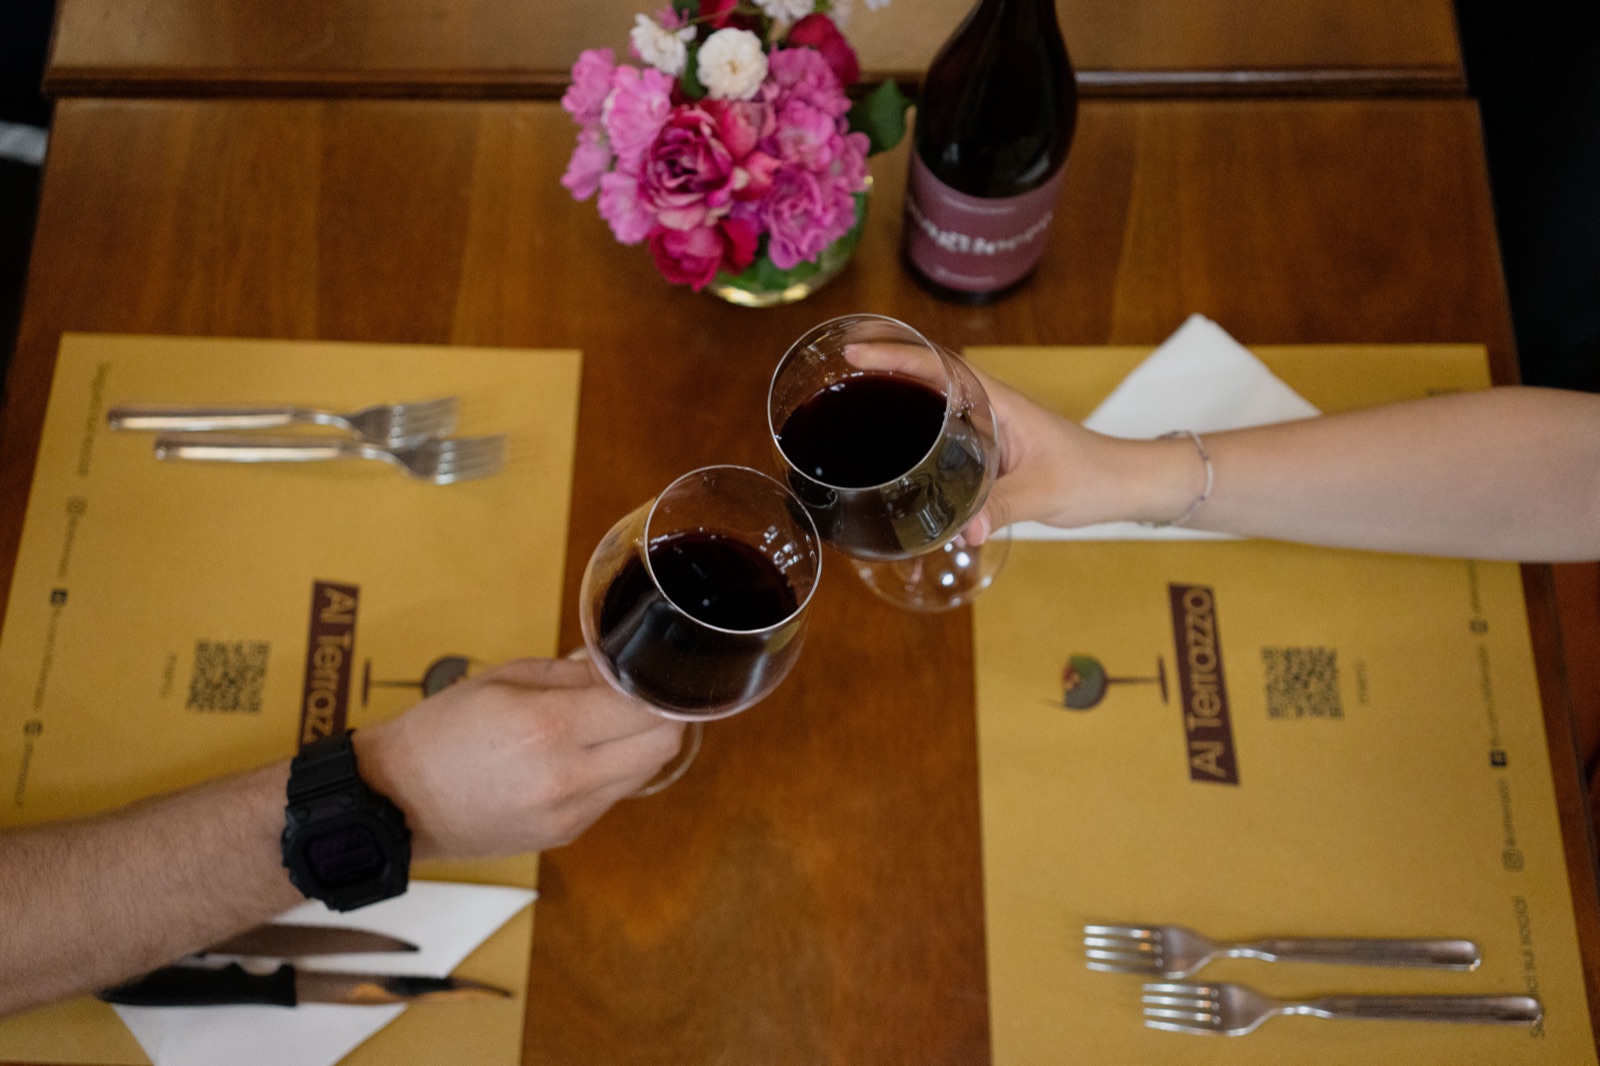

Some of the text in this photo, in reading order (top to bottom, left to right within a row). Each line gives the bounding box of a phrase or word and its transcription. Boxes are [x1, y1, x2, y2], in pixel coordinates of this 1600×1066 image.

[303, 634, 352, 745] Terraz
[1182, 587, 1227, 777] Al Terrazzo
